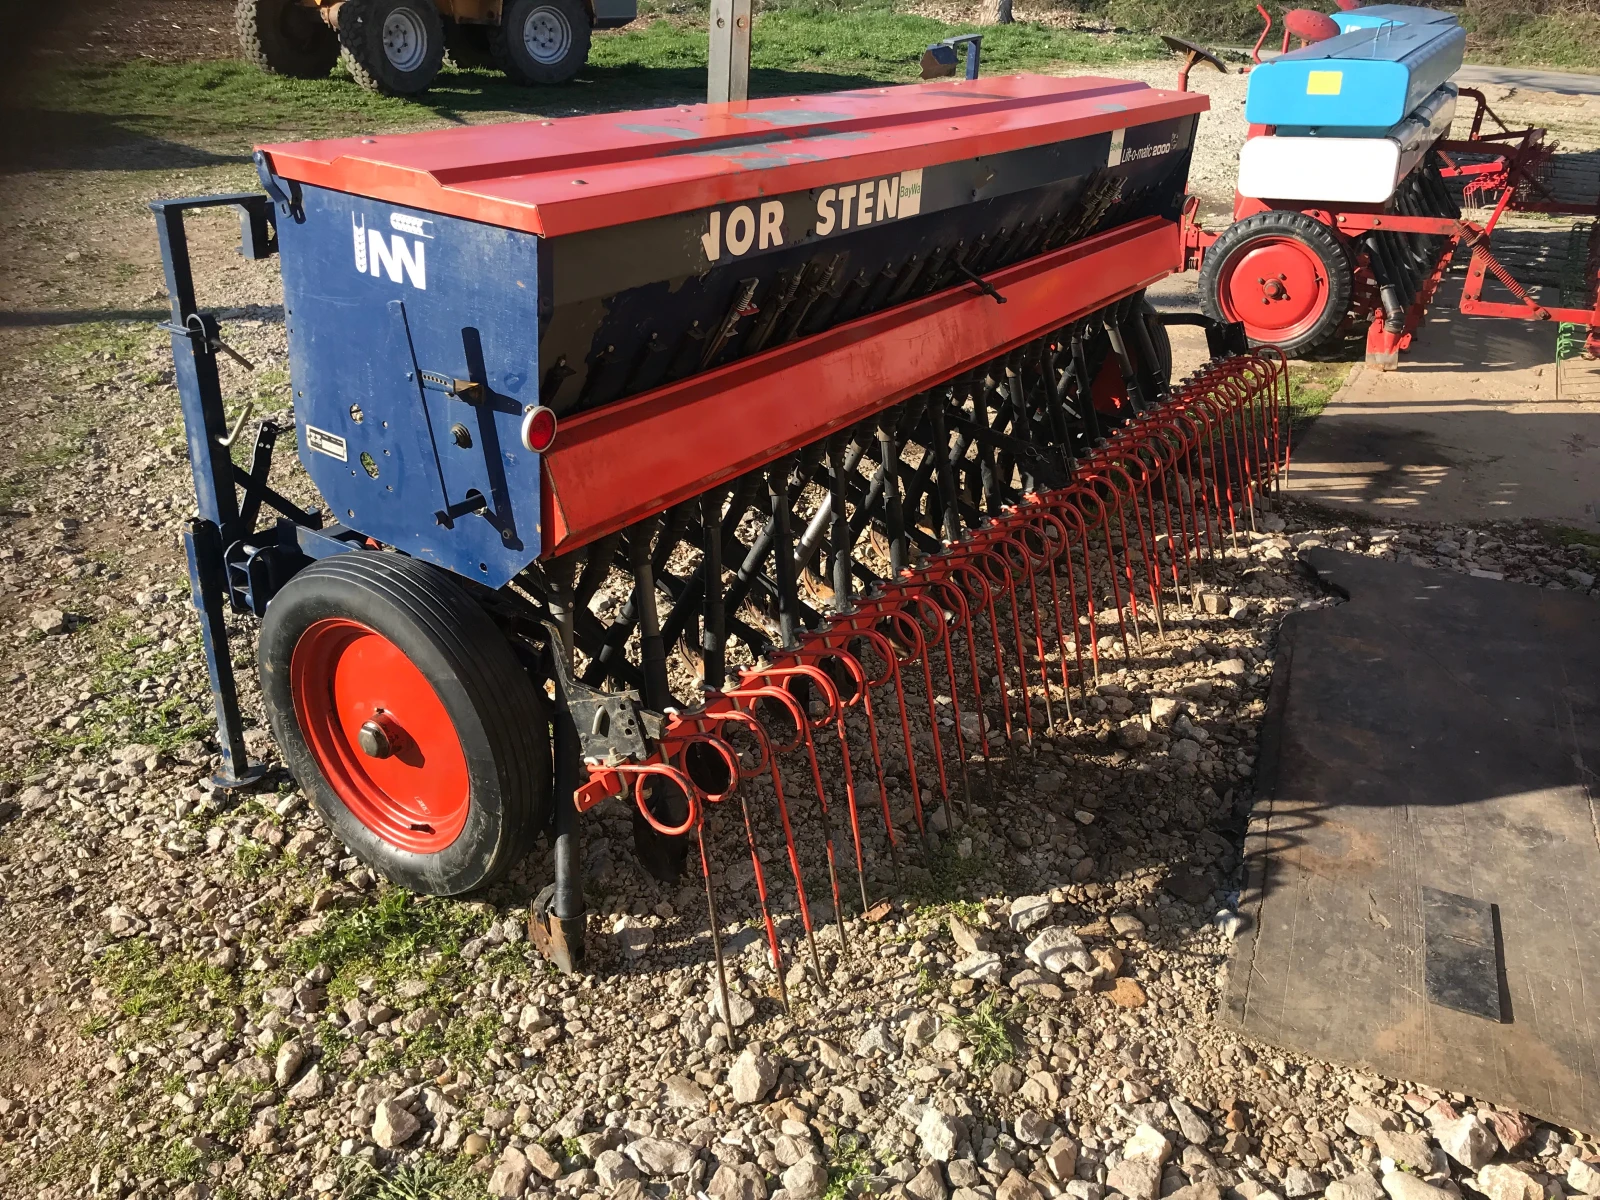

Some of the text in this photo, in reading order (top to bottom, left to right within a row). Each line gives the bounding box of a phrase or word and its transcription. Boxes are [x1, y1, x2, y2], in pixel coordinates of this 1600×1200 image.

[1152, 142, 1171, 157] 2000
[900, 183, 921, 198] BayWa
[816, 176, 899, 236] STEN
